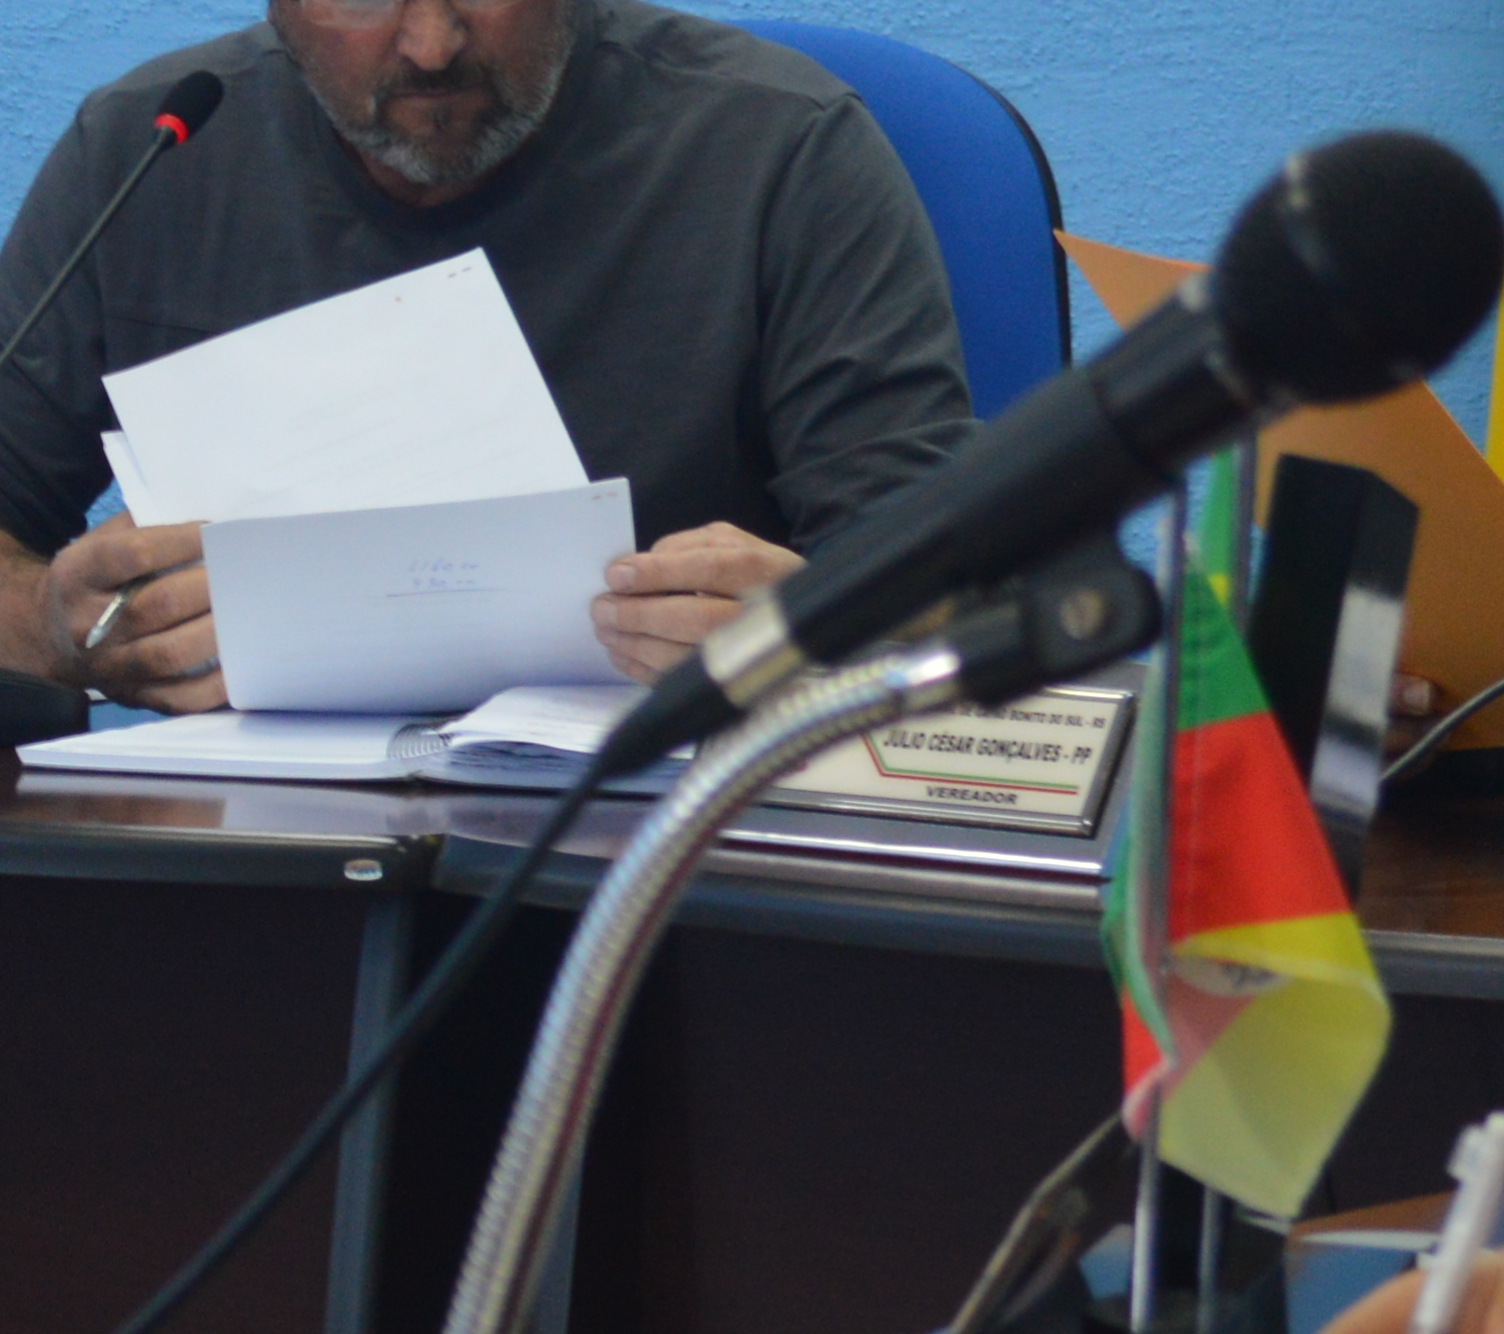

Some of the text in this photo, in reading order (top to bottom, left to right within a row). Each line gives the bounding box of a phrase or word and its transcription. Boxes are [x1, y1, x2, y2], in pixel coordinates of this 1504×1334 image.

[1010, 709, 1046, 724] BONITO
[1049, 713, 1063, 725] DO
[1065, 714, 1084, 727] SUL
[1093, 717, 1106, 729] RS
[977, 736, 1062, 763] GONÇALVES
[1070, 745, 1093, 764] PP
[926, 786, 1018, 805] VEREADOR
